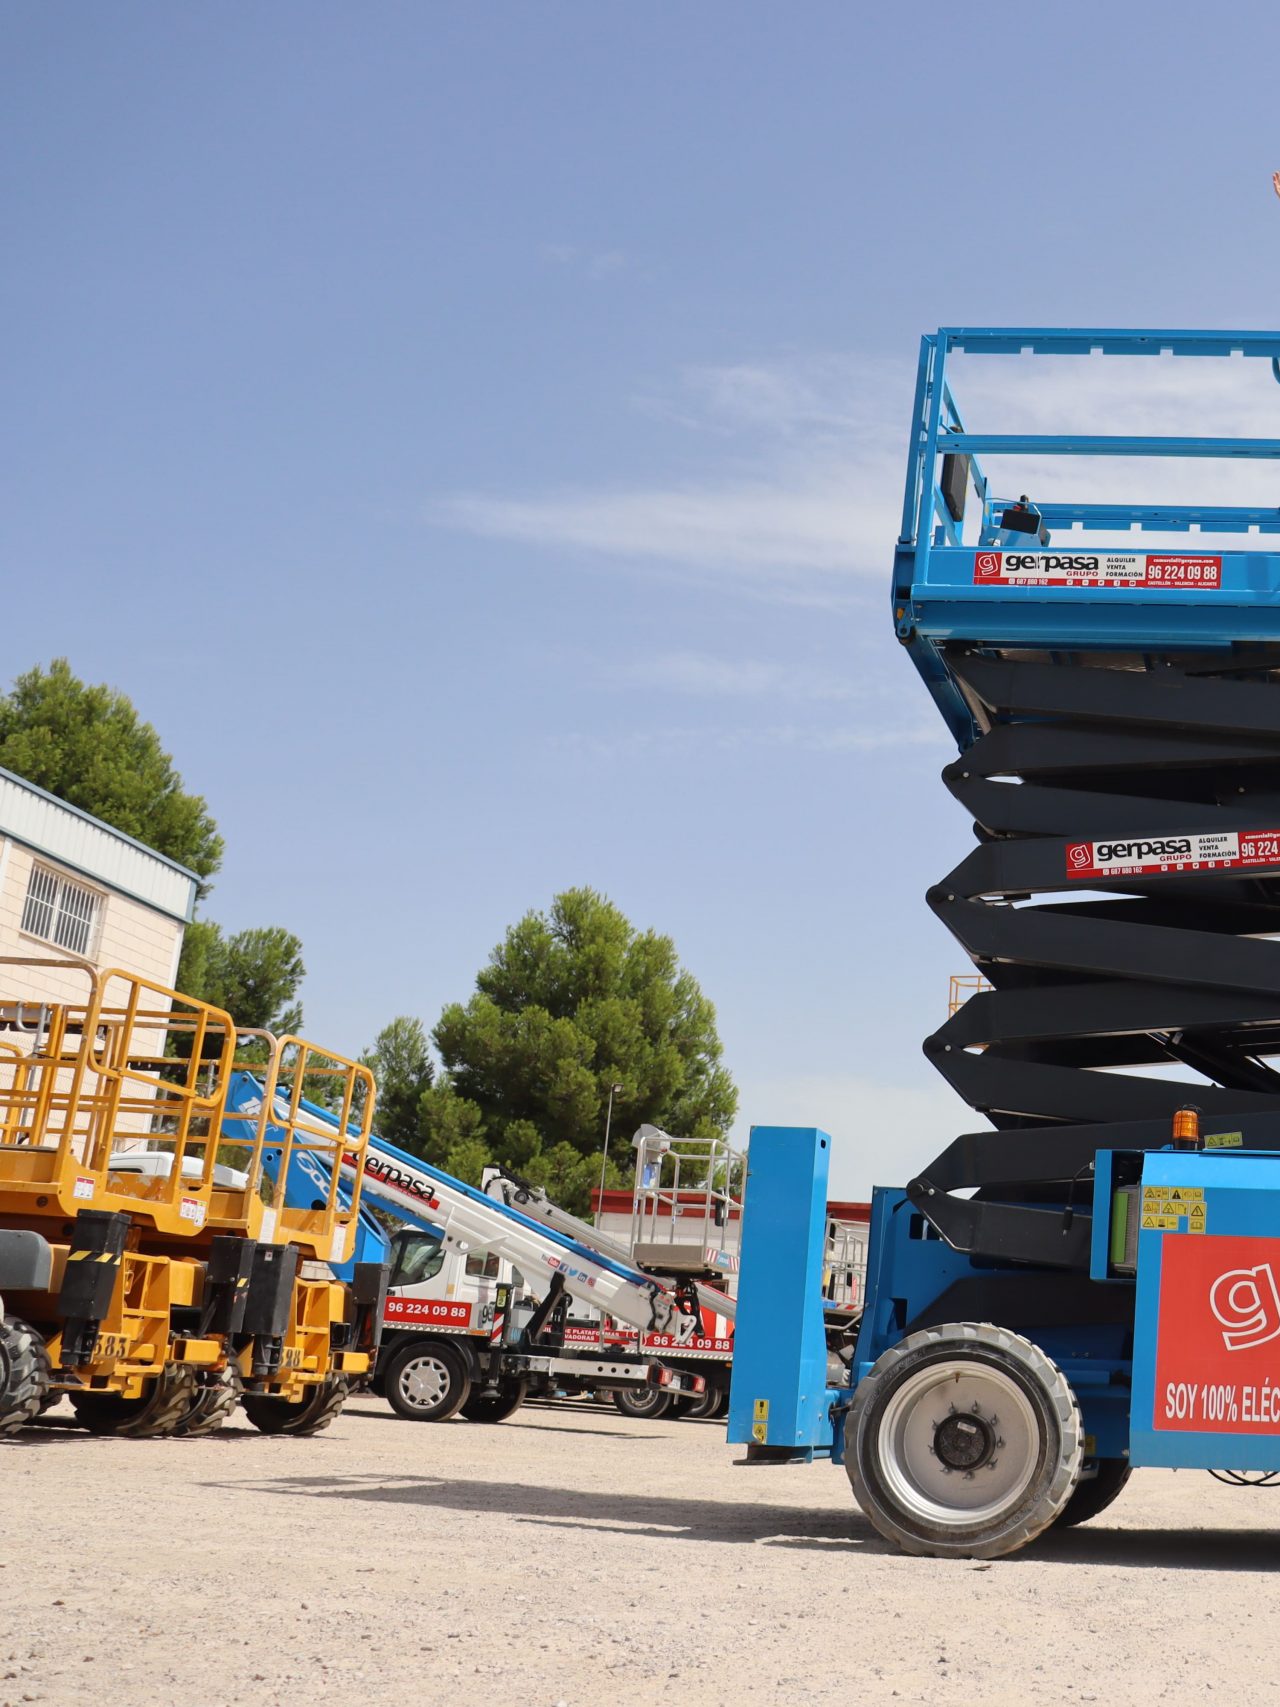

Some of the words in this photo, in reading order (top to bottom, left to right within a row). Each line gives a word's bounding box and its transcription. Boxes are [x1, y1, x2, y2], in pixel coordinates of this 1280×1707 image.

[1005, 554, 1099, 573] gerpasa
[1148, 565, 1162, 579] 96
[1164, 565, 1185, 580] 224
[1187, 565, 1201, 580] 09
[1203, 566, 1218, 580] 88
[1198, 836, 1228, 844] ALQUILER
[1097, 839, 1191, 862] gerpasa
[1199, 850, 1237, 859] FORMACIÓN
[1241, 842, 1255, 857] 96
[1257, 840, 1279, 856] 224
[1159, 854, 1192, 862] GRUPO
[388, 1302, 404, 1313] 96
[406, 1303, 429, 1316] 224
[432, 1306, 448, 1316] 09
[450, 1307, 467, 1318] 88
[653, 1335, 669, 1346] 96
[697, 1338, 712, 1349] 09
[714, 1340, 730, 1350] 88
[1165, 1382, 1197, 1419] SOY
[1201, 1384, 1238, 1422] 100%
